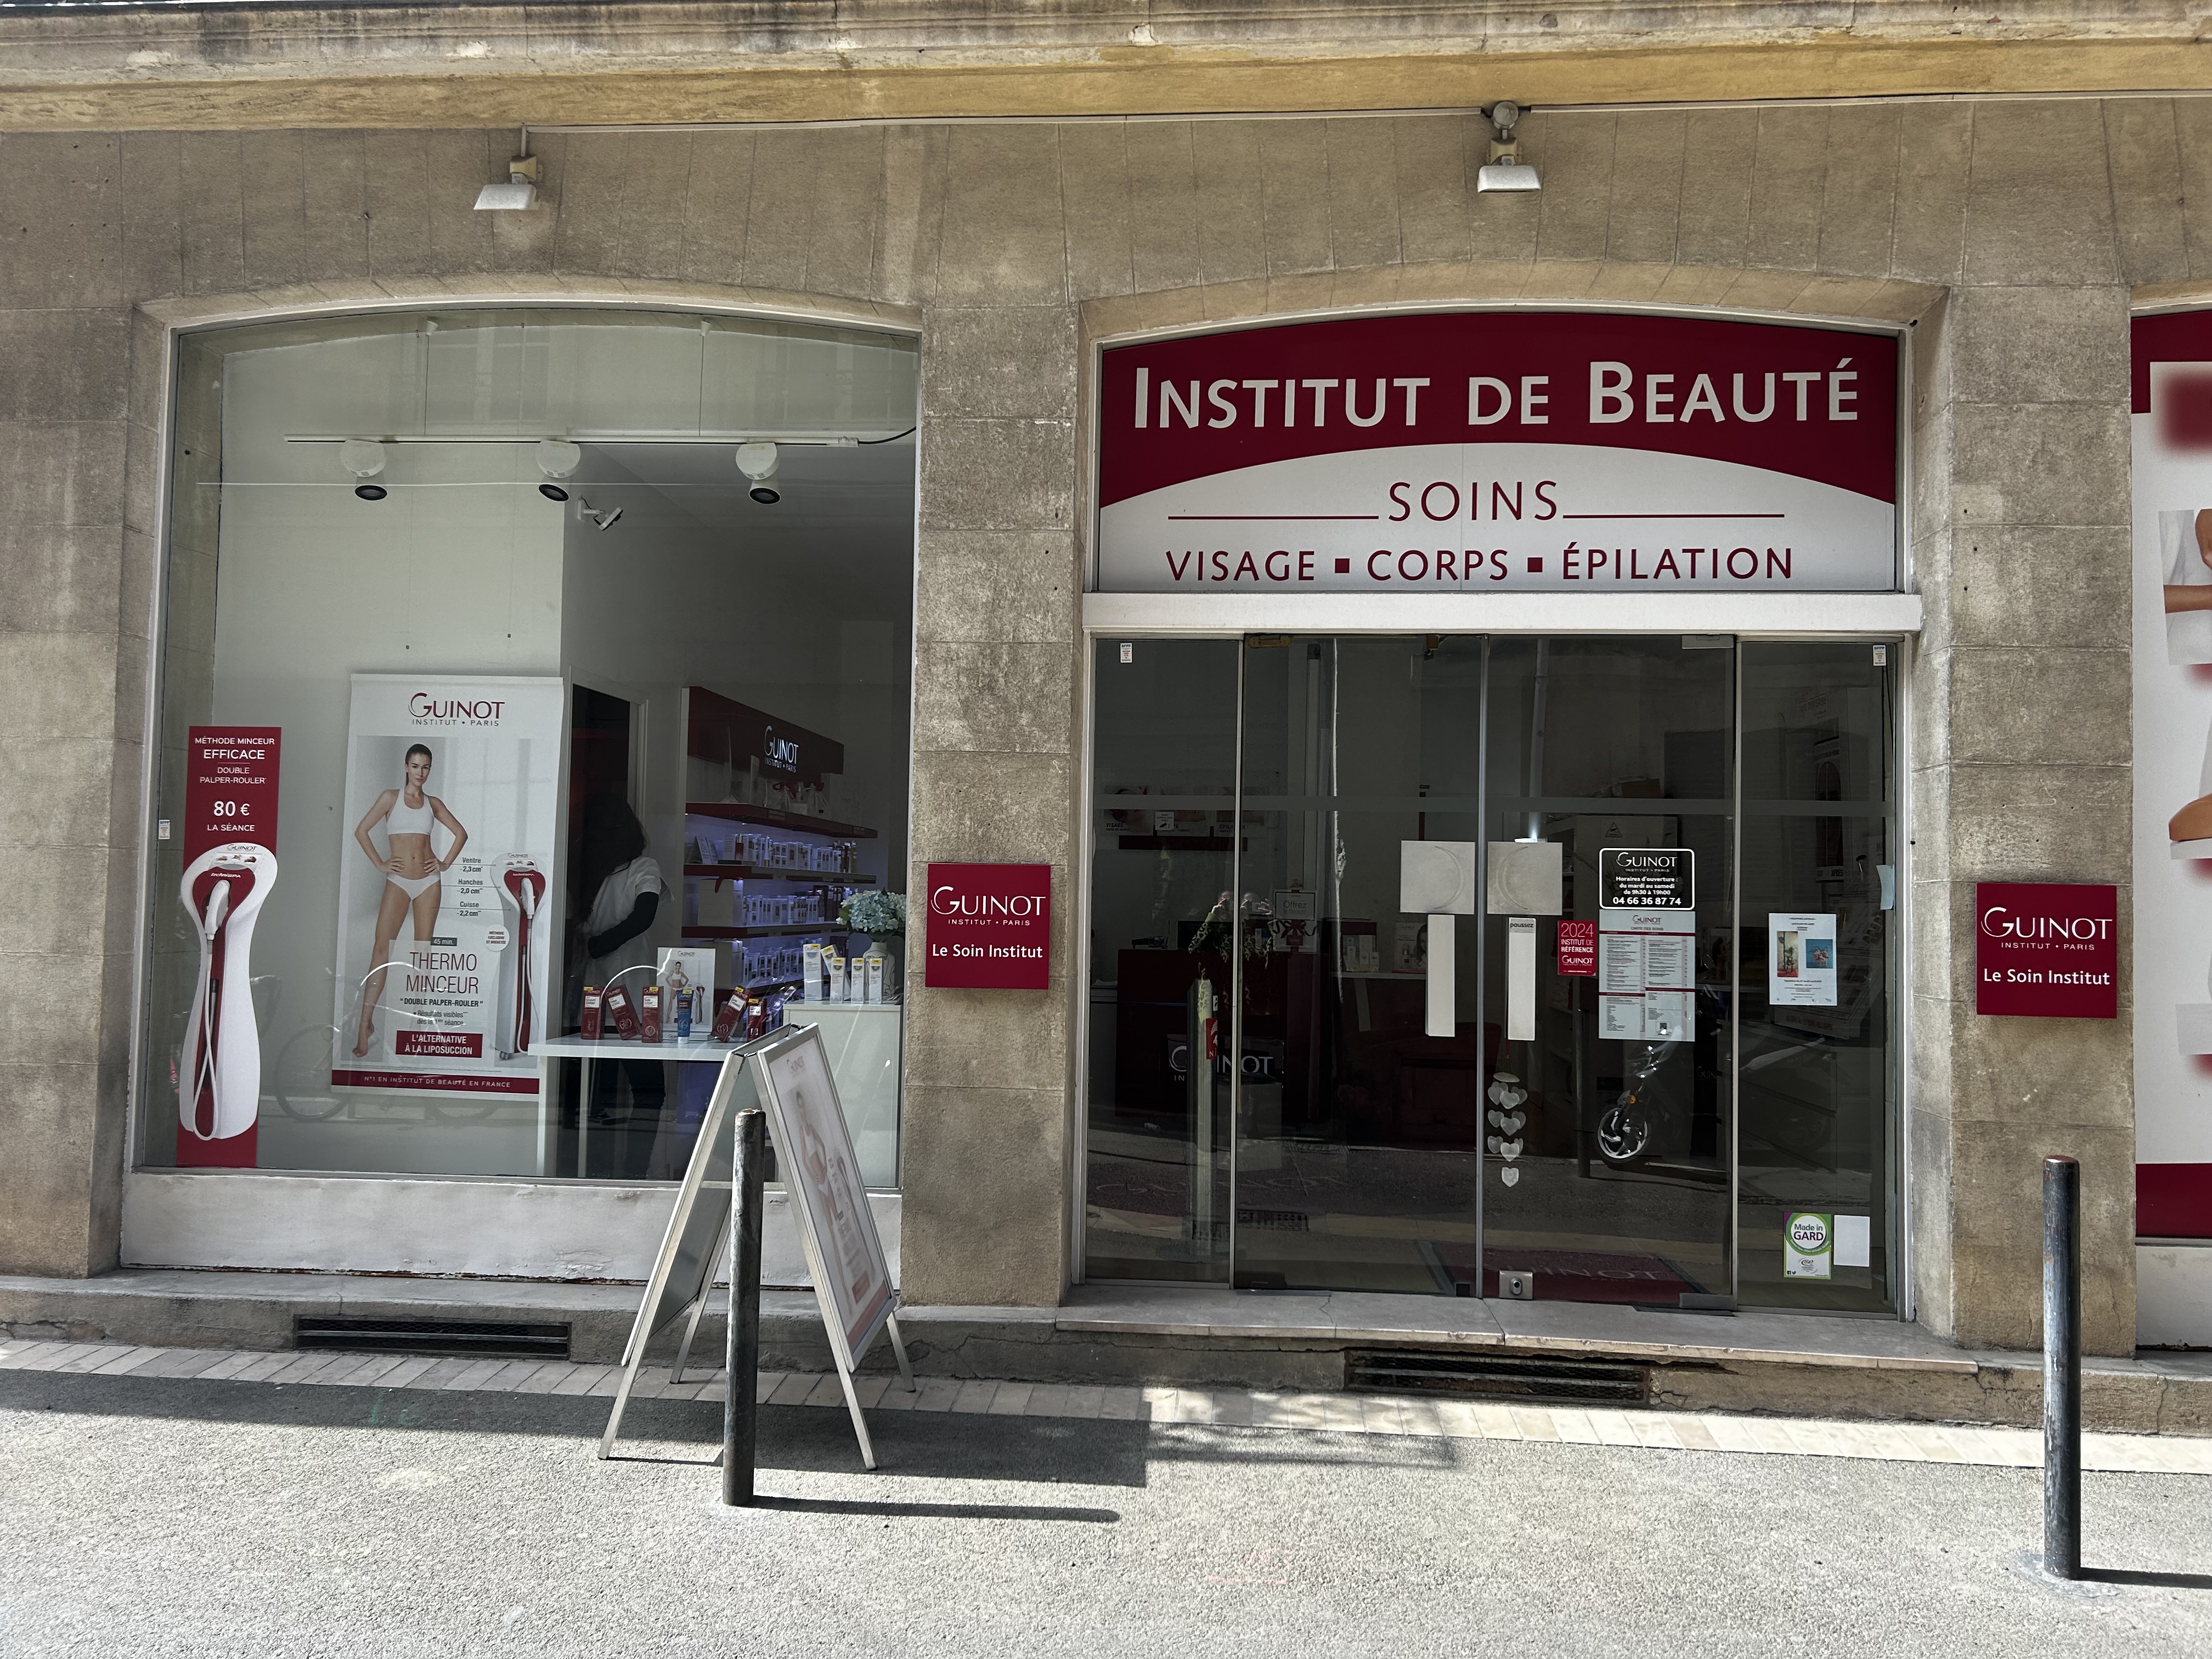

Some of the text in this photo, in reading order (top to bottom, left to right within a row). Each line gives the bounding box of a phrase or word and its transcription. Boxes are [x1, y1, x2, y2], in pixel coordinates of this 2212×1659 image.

[1136, 359, 1858, 428] INSTITUT DE BEAUTÉ
[1389, 481, 1558, 522] SOINS
[1167, 543, 1791, 582] VISAGE CORPS ÉPILATION
[408, 692, 505, 719] GUINOT
[195, 736, 235, 744] MÉTHODE
[764, 725, 799, 764] GUINOT
[204, 749, 265, 759] EFFICACE
[213, 801, 250, 816] 80 €
[221, 823, 255, 832] SÉANCE
[1616, 852, 1678, 867] GUINOT
[930, 886, 1046, 916] GUINOT
[1633, 915, 1662, 923] GUINOT
[1981, 907, 2113, 939] GUINOT
[1561, 923, 1594, 937] 2024
[933, 944, 1043, 958] Le Soin Institut
[409, 952, 477, 971] THERMO
[1561, 955, 1593, 964] GUINOT
[1984, 968, 2110, 985] Le Soin Institut
[406, 975, 478, 994] MINCEUR
[412, 1034, 466, 1043] L'ALTERNATIVE
[405, 1043, 410, 1052] À
[424, 1045, 472, 1054] LIPOSUCCION
[1793, 1231, 1824, 1241] GARD
